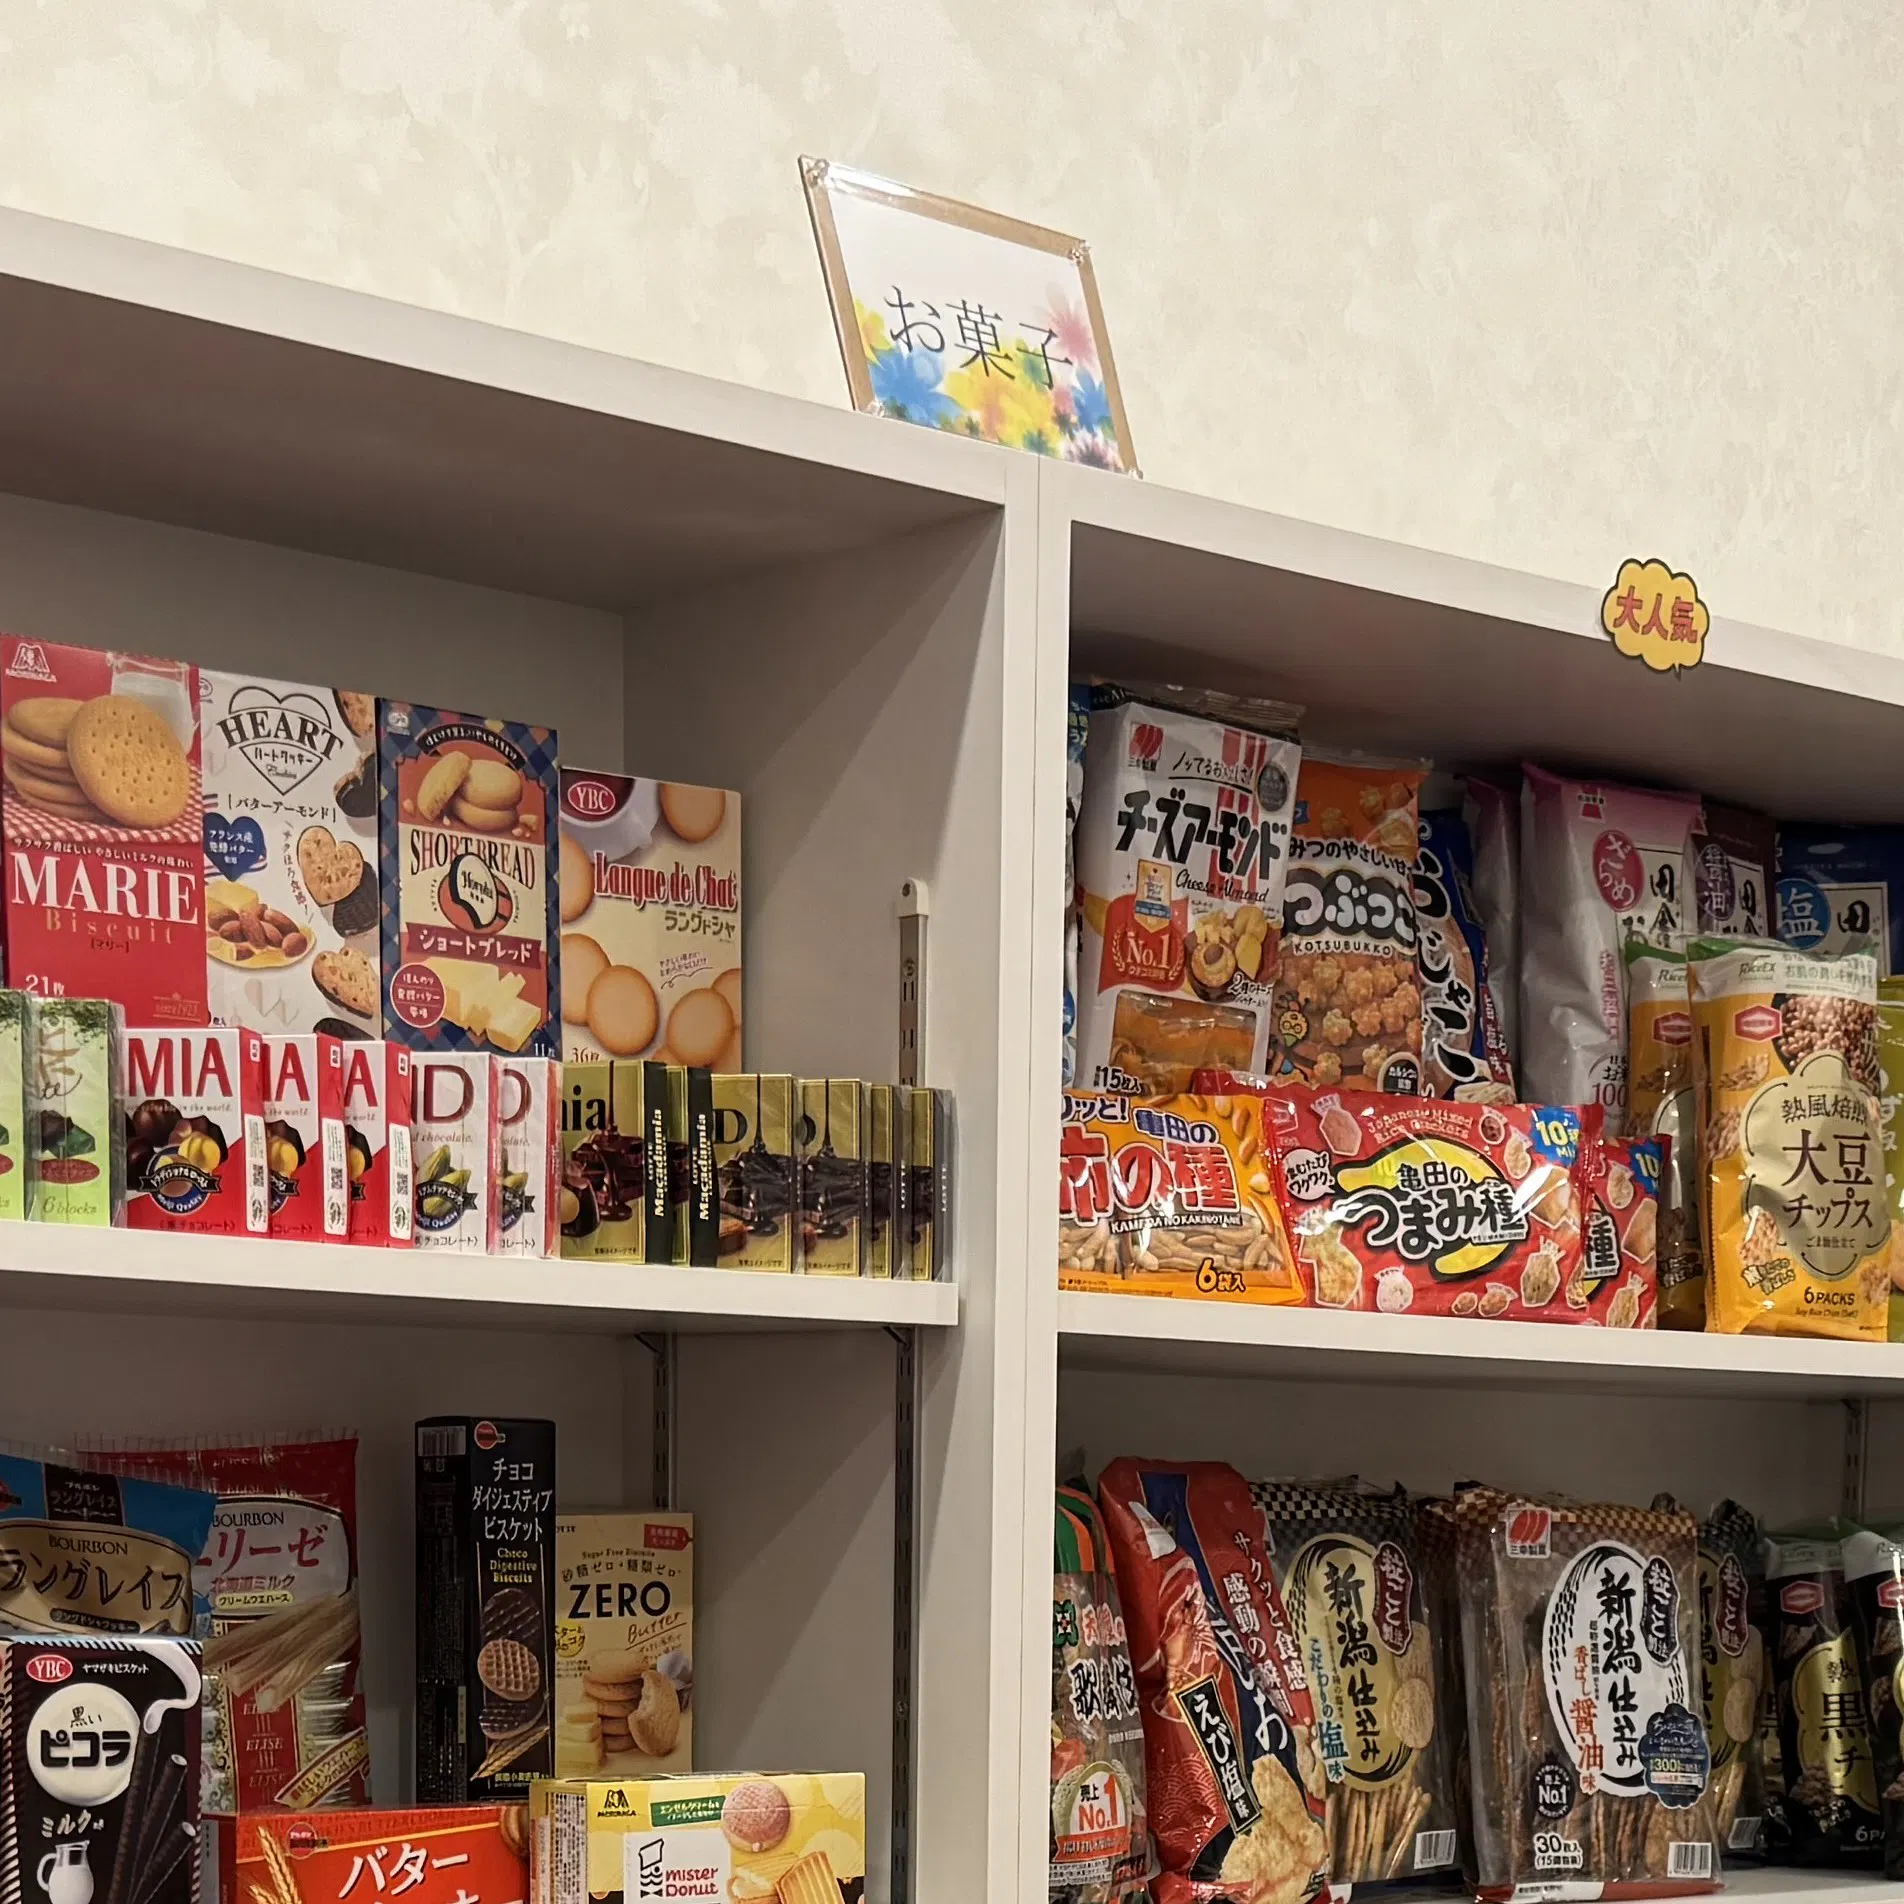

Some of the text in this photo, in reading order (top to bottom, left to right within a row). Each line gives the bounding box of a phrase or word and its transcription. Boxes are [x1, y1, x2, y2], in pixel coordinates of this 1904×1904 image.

[884, 285, 1073, 391] お菓子
[1613, 585, 1698, 643] 大人気
[5, 667, 57, 684] MORINAGA
[218, 709, 344, 765] HEART
[251, 744, 314, 767] ハートクッキー
[575, 787, 611, 809] YBC
[1114, 790, 1288, 880] チーズアーモンド
[1175, 869, 1270, 904] Cheese Almond
[1600, 836, 1636, 903] ざらめ
[12, 853, 198, 926] MARIE
[46, 912, 175, 945] Biscuit
[663, 908, 737, 938] ラングドシャ
[1777, 892, 1821, 942] 塩
[417, 929, 533, 962] ショートブレッド
[1126, 938, 1169, 968] No.1
[1136, 1111, 1216, 1142] 亀田の
[1398, 1161, 1470, 1190] 亀田の
[1780, 1132, 1874, 1188] 大豆
[1781, 1189, 1874, 1229] チップス
[1197, 1258, 1246, 1292] 6袋入
[491, 1459, 536, 1482] チョコ
[211, 1509, 284, 1528] BOURBON
[484, 1514, 544, 1543] ビスケット
[48, 1534, 128, 1556] BOURBON
[568, 1581, 672, 1619] ZERO
[34, 1659, 66, 1680] YBC
[1323, 1561, 1386, 1762] 新潟仕込み
[1596, 1569, 1643, 1769] 新潟仕込み
[70, 1705, 104, 1728] 黒い
[38, 1730, 131, 1768] ピコラ
[1194, 1693, 1250, 1819] えび塩味
[338, 1840, 469, 1899] バター
